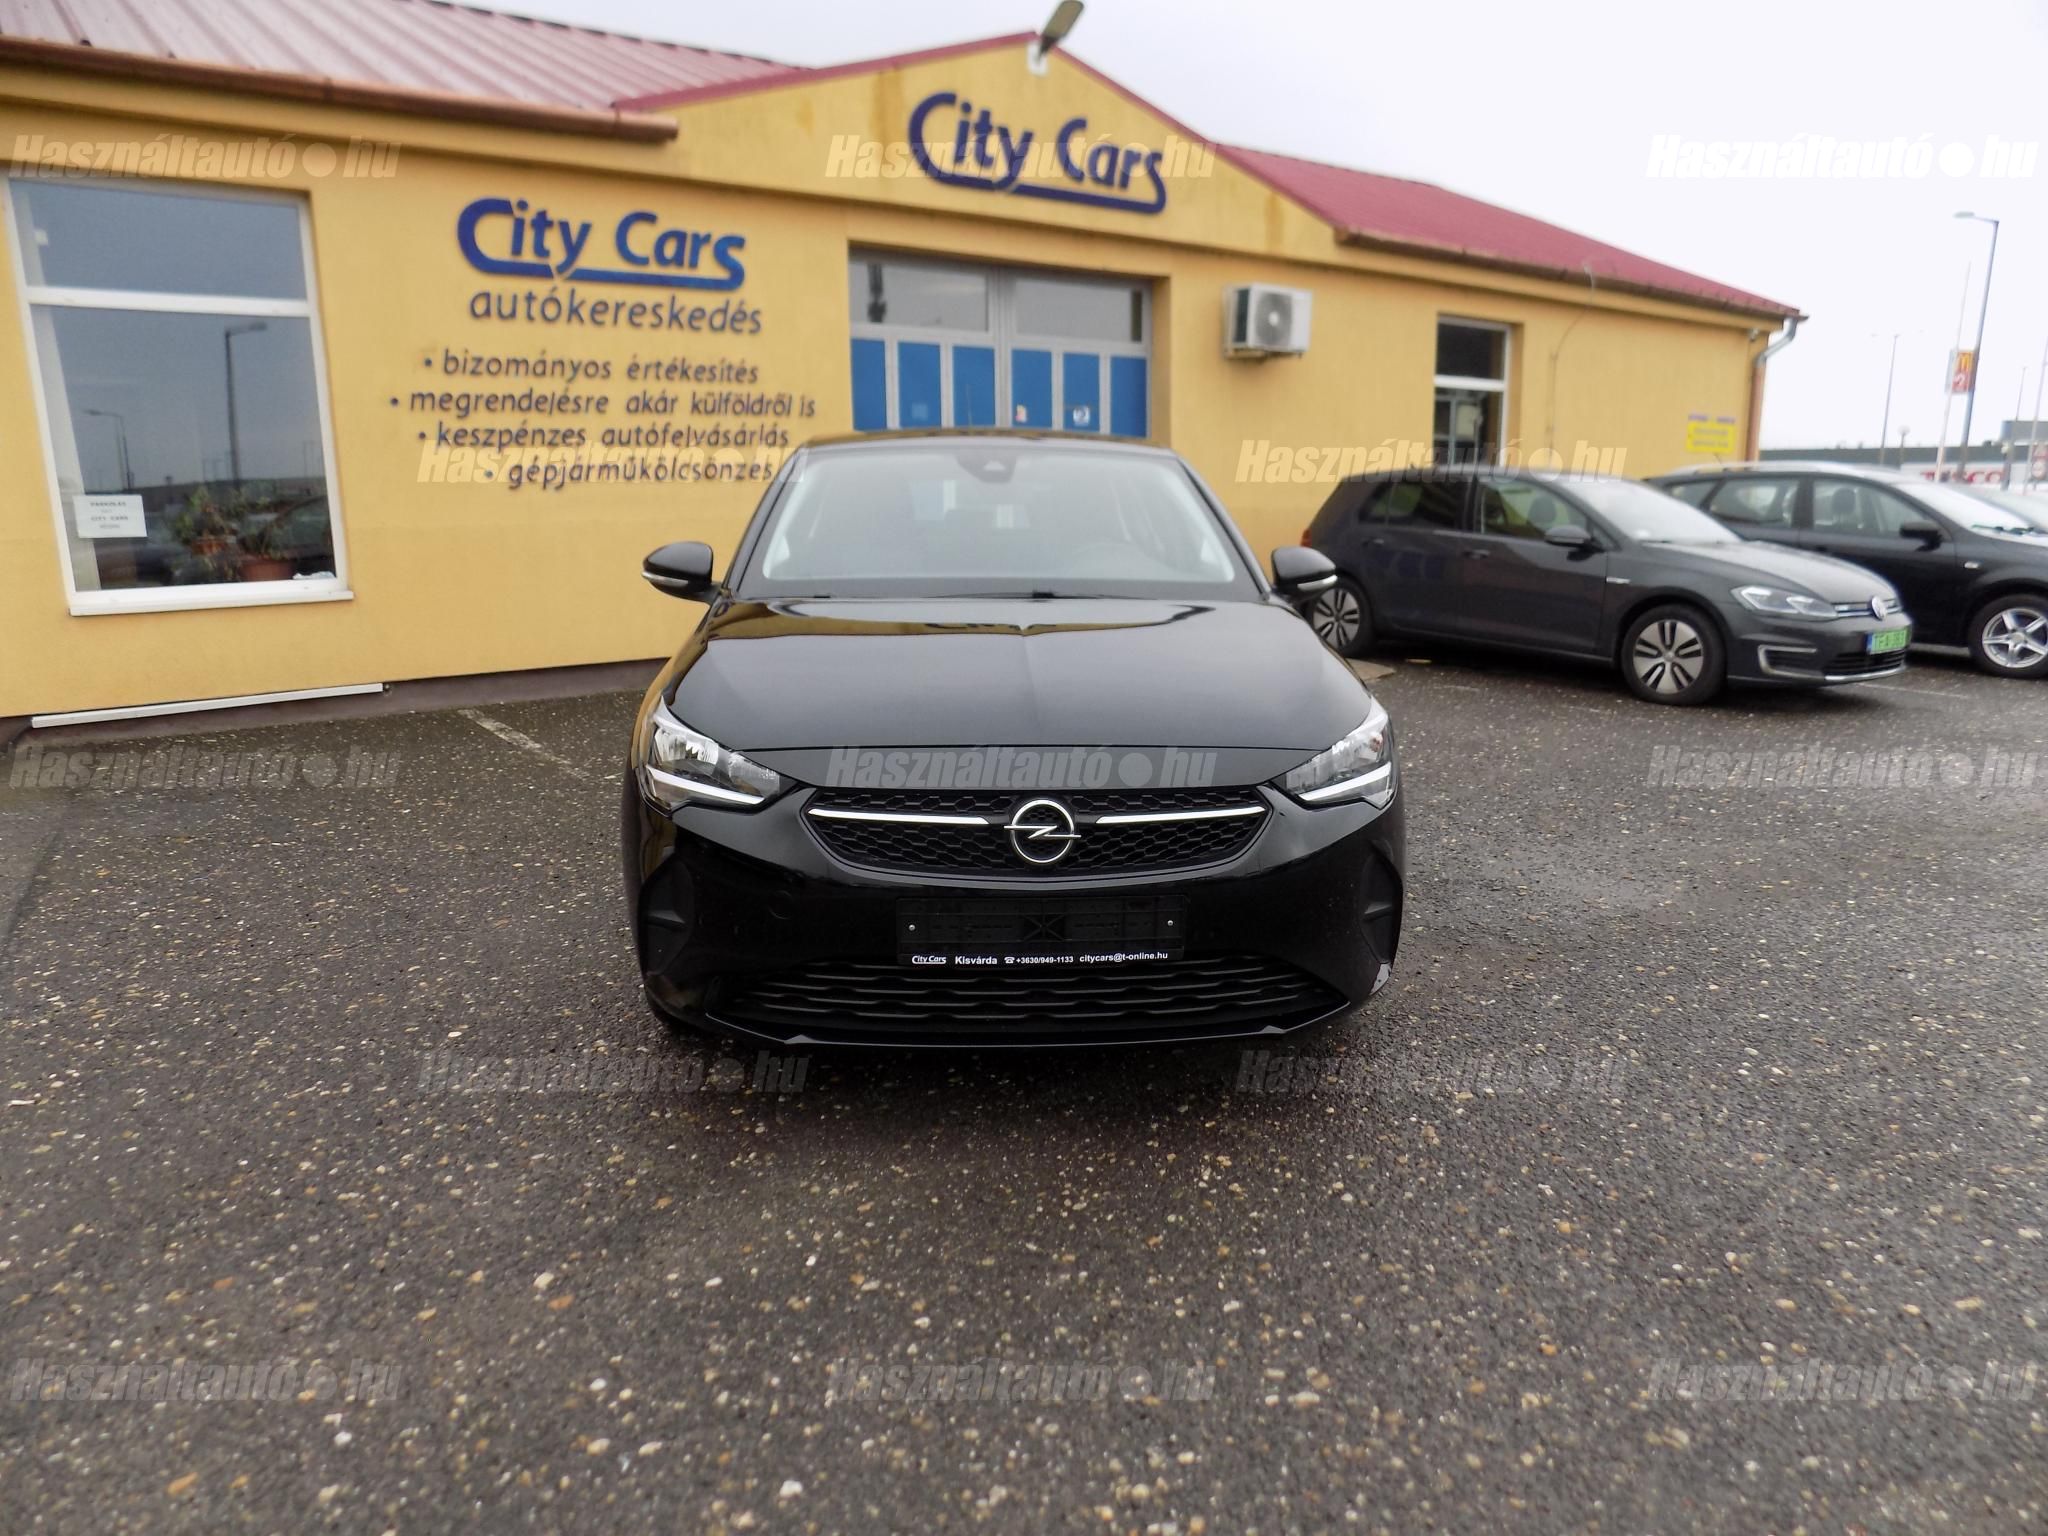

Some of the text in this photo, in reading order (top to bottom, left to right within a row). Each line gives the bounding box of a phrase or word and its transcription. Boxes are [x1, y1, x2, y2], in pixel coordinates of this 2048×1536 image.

[908, 91, 1167, 214] City Cars
[457, 197, 591, 280] City
[470, 286, 762, 335] autókereskedés
[443, 348, 758, 384] bizományos értékesítés
[409, 386, 815, 419] megrendelésre akár külföldről is
[601, 421, 789, 447] autófelvásárlás
[955, 955, 998, 965] Kisvárda
[1079, 951, 1168, 963] citycars@t-online.hu
